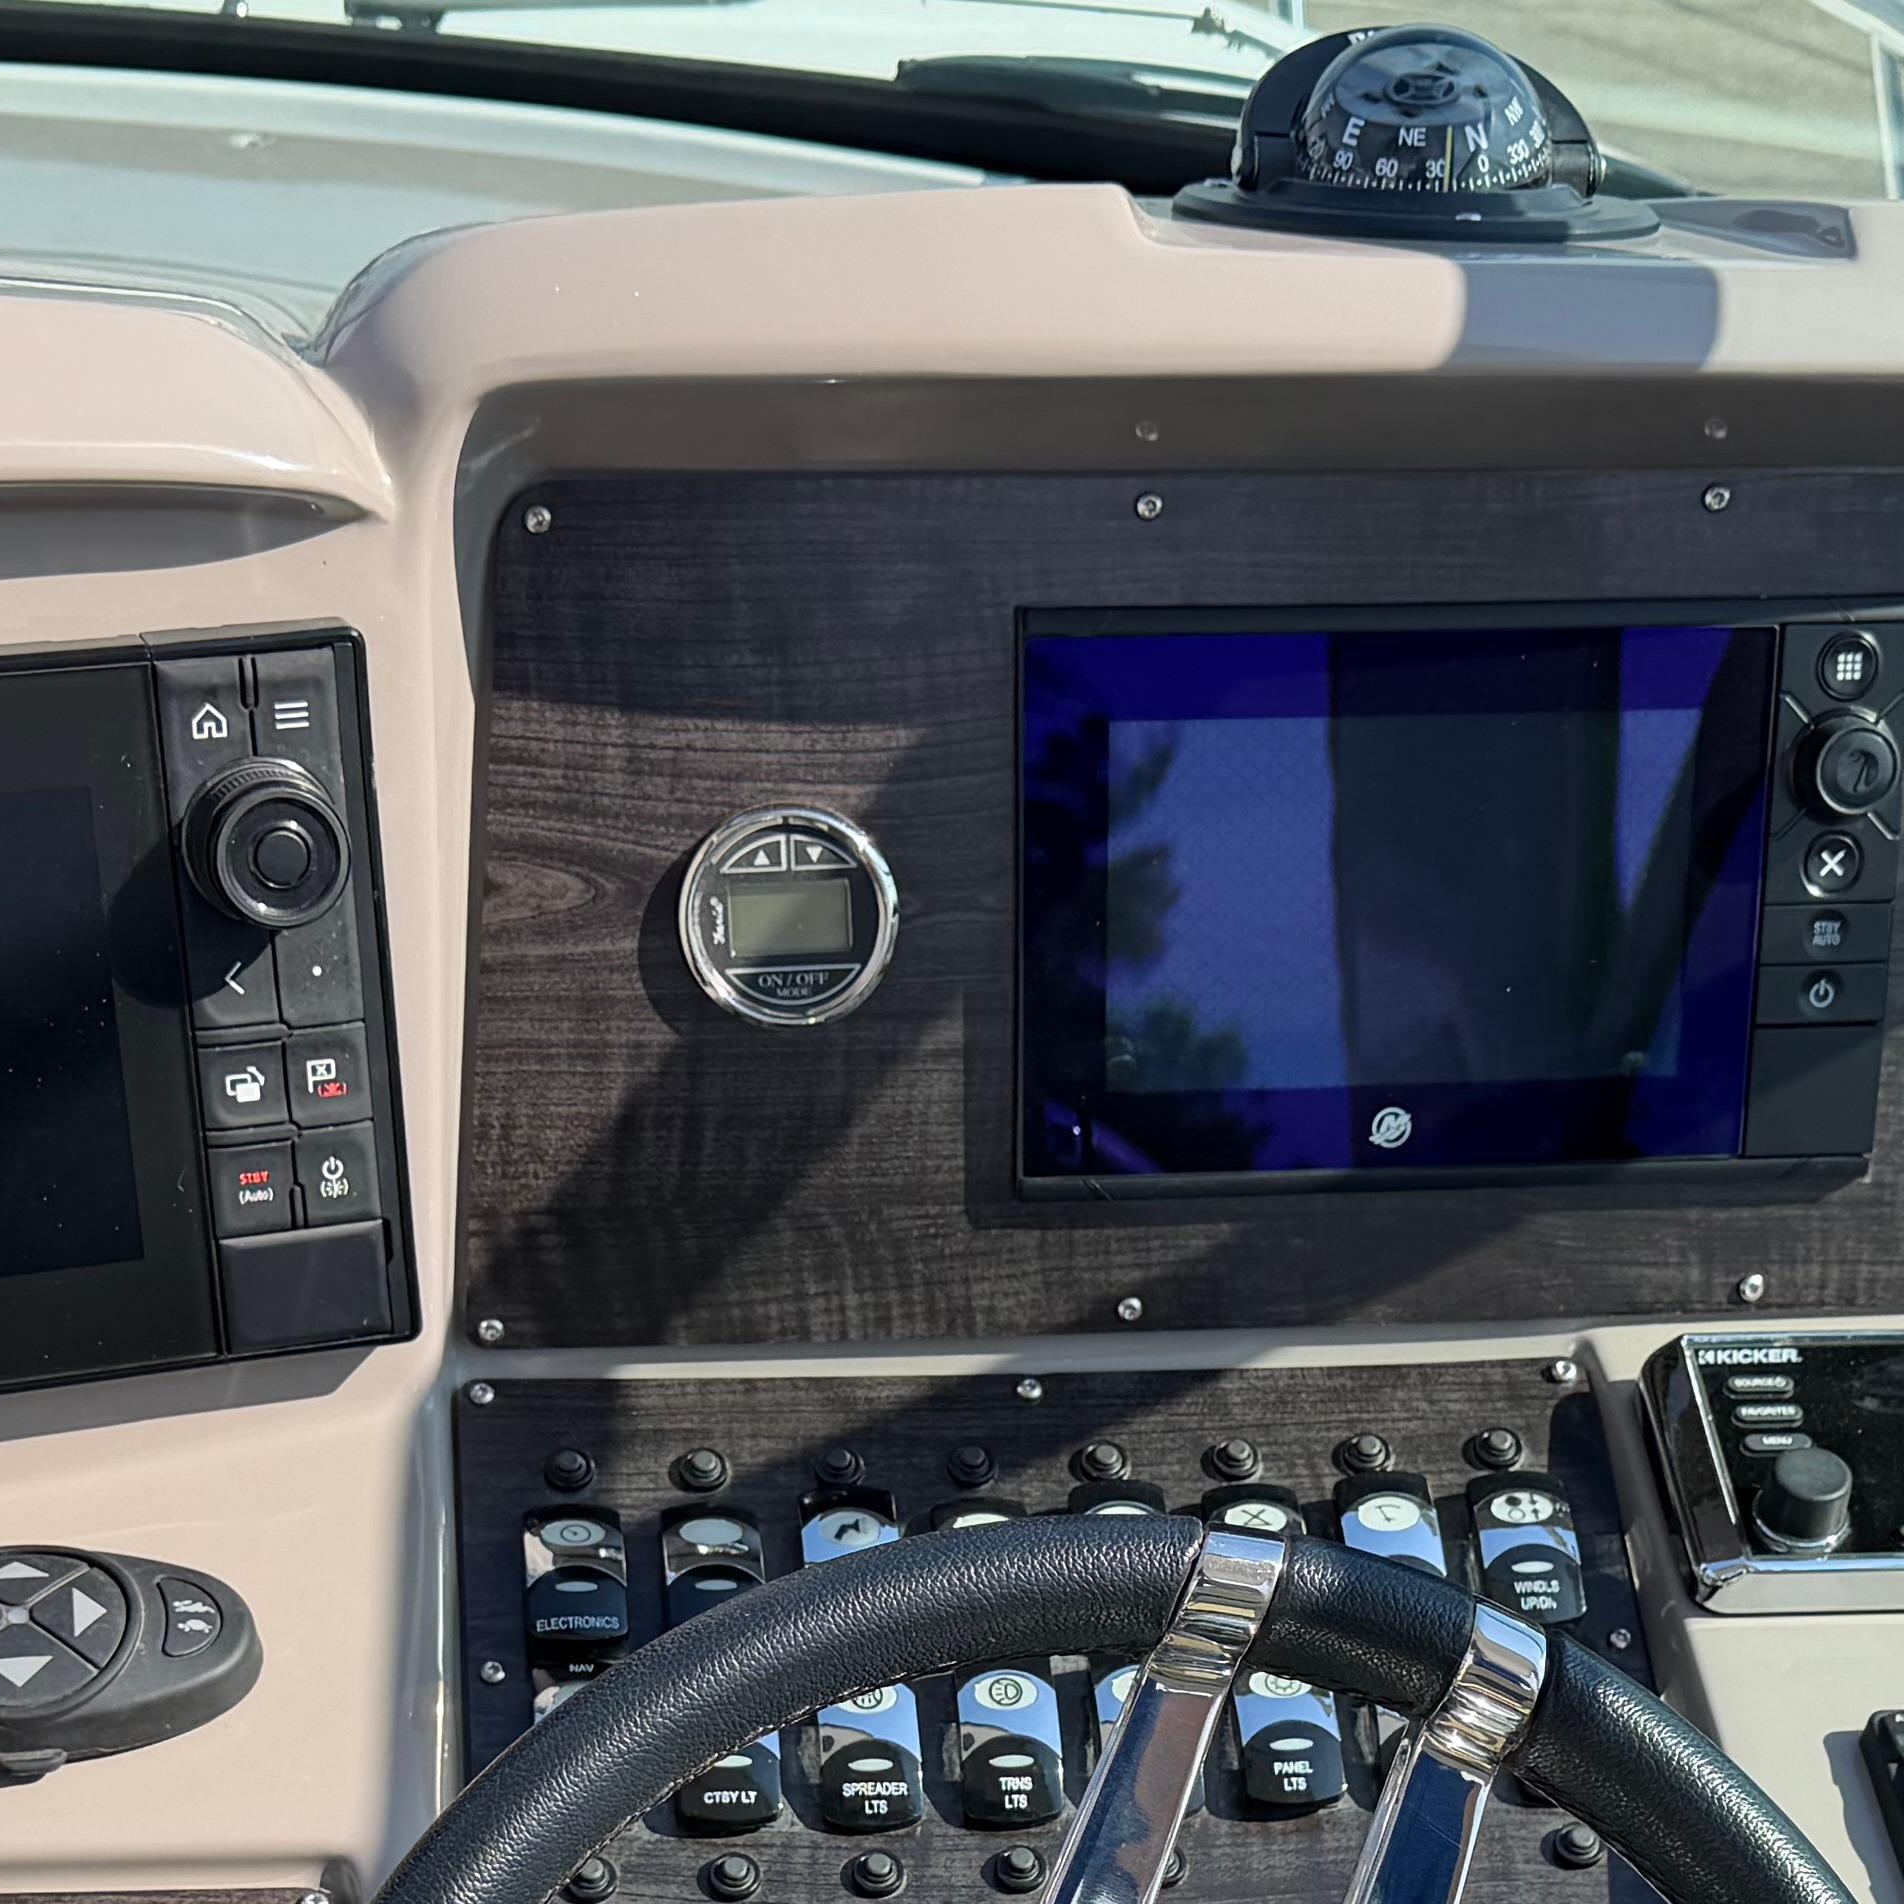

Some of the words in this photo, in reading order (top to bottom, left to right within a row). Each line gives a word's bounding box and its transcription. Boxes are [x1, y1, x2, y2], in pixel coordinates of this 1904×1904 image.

[1342, 117, 1365, 146] E
[1398, 126, 1426, 147] NE
[1464, 122, 1489, 152] N
[1333, 150, 1353, 170] 90
[1375, 158, 1398, 177] 60
[1425, 158, 1445, 178] 30
[1477, 154, 1490, 173] 0
[758, 974, 784, 987] ON
[796, 971, 830, 986] OFF
[239, 1171, 270, 1185] STBY
[536, 1616, 620, 1632] ELECTRONICS
[1274, 1761, 1314, 1776] PANEL
[842, 1782, 909, 1797] SPREADER
[999, 1776, 1033, 1791] TRNS
[1284, 1776, 1307, 1791] LTS
[740, 1790, 757, 1804] LT
[1004, 1793, 1028, 1809] LTS
[864, 1799, 888, 1815] LTS
